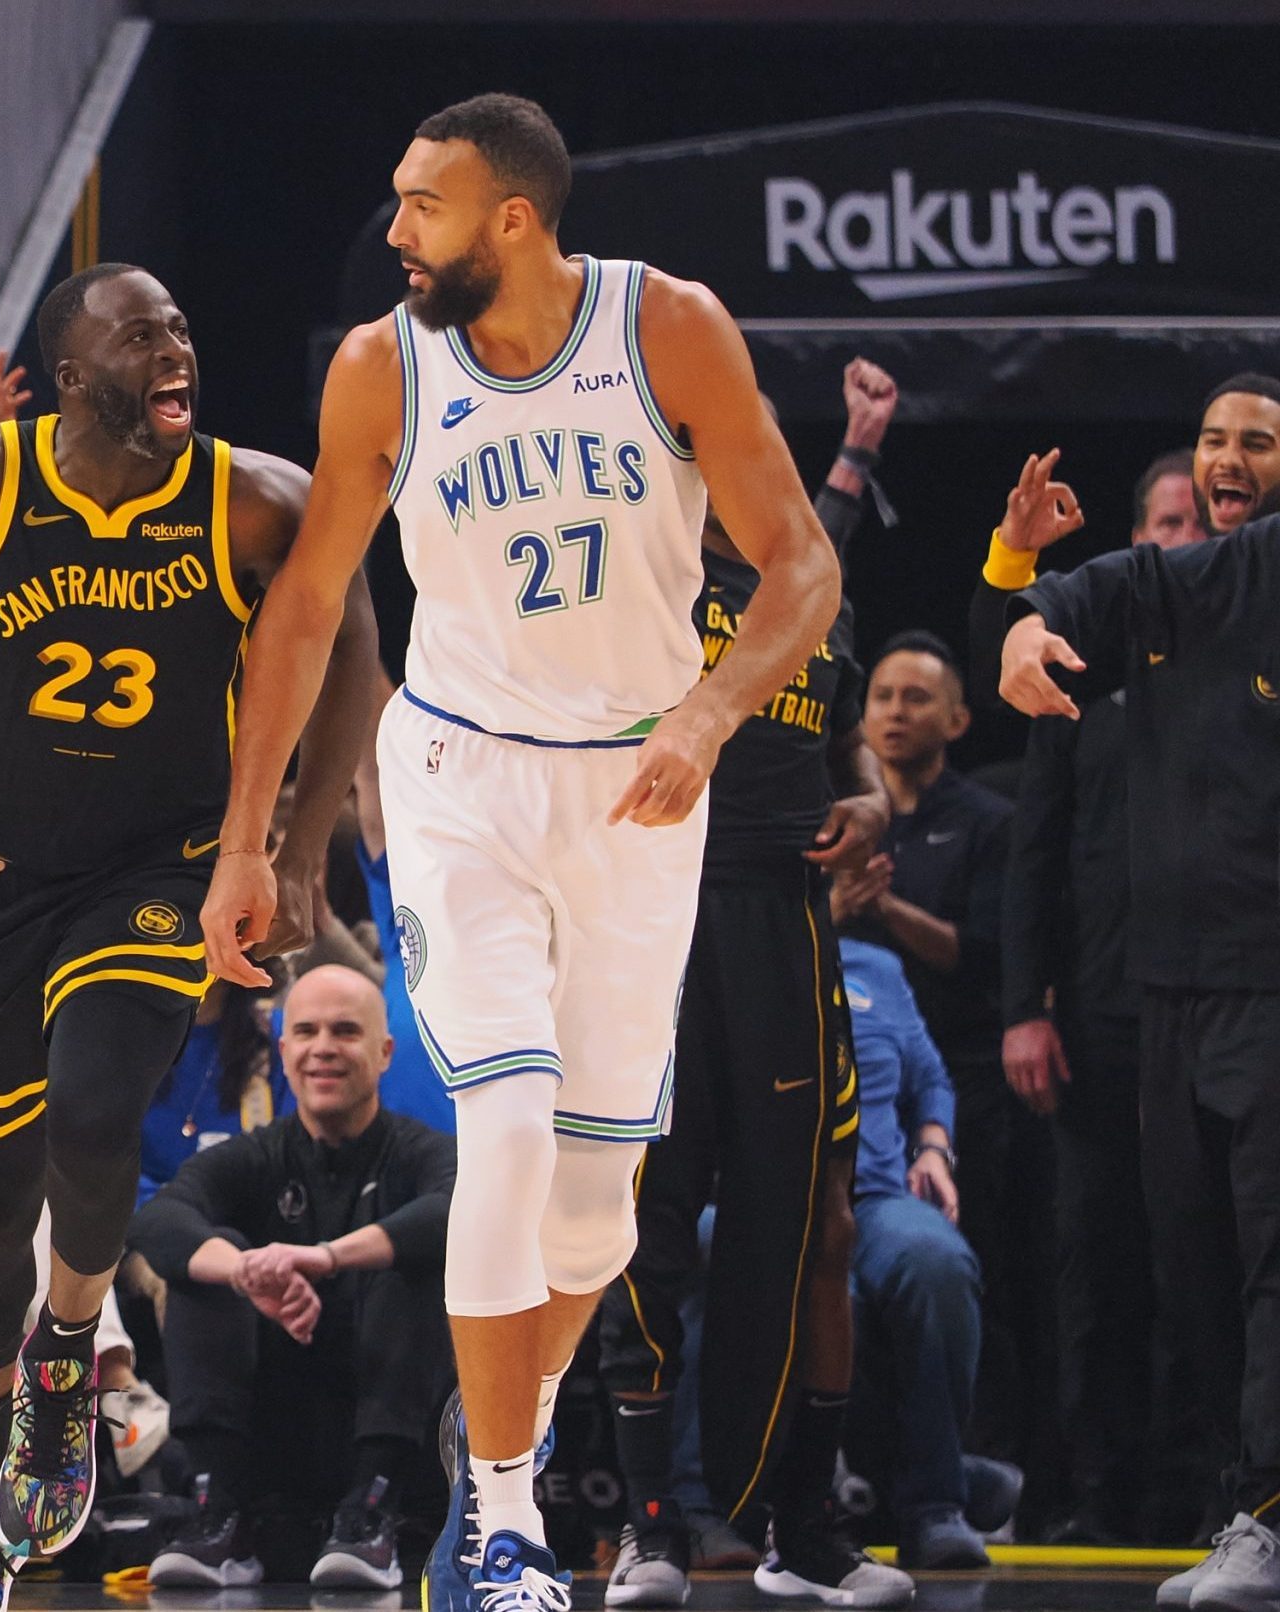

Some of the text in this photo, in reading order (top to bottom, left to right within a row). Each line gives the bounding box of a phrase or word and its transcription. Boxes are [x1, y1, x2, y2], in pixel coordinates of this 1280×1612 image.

[764, 168, 1176, 274] Rakuten
[433, 429, 648, 536] WOLVES
[141, 523, 203, 541] Rakuten
[504, 517, 608, 619] 27
[50, 553, 208, 611] FRANCISCO
[28, 641, 156, 728] 23
